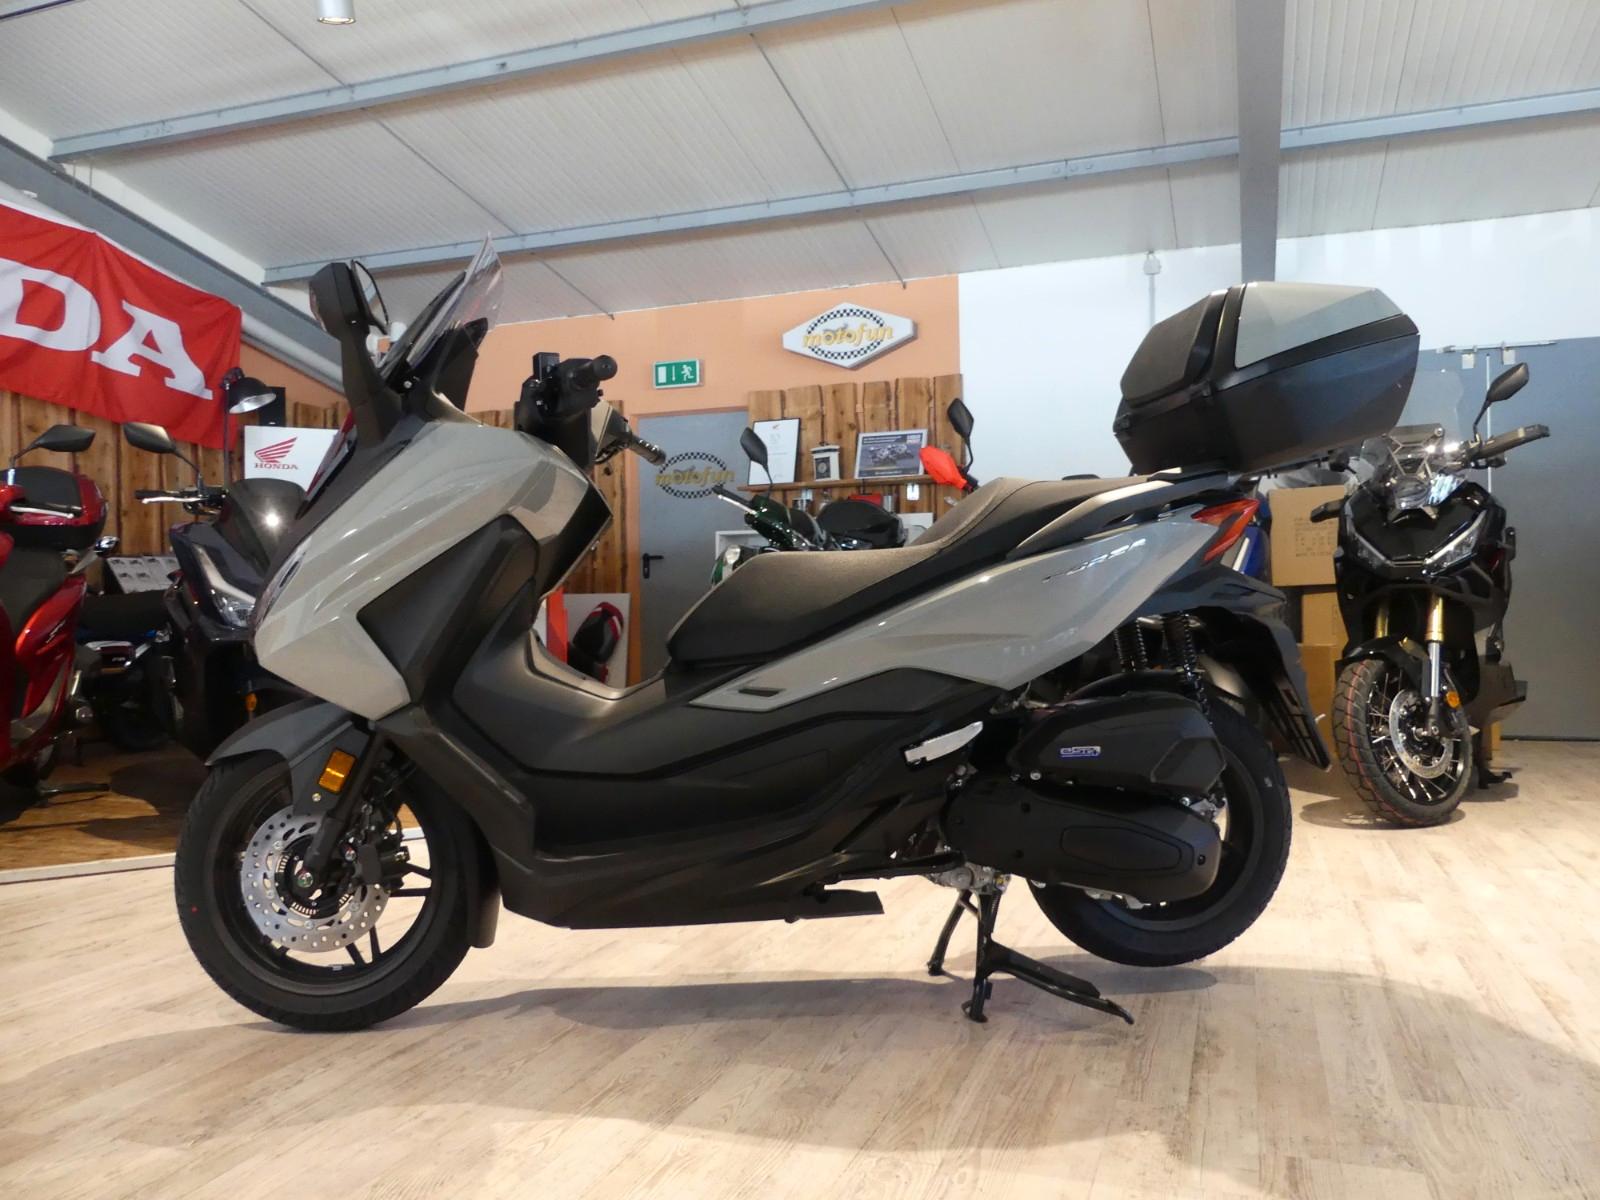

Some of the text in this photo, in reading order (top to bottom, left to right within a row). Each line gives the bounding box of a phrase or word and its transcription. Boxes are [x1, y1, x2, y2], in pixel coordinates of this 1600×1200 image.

[802, 322, 895, 347] motofun
[254, 462, 299, 470] HONDA
[656, 466, 736, 488] motofun
